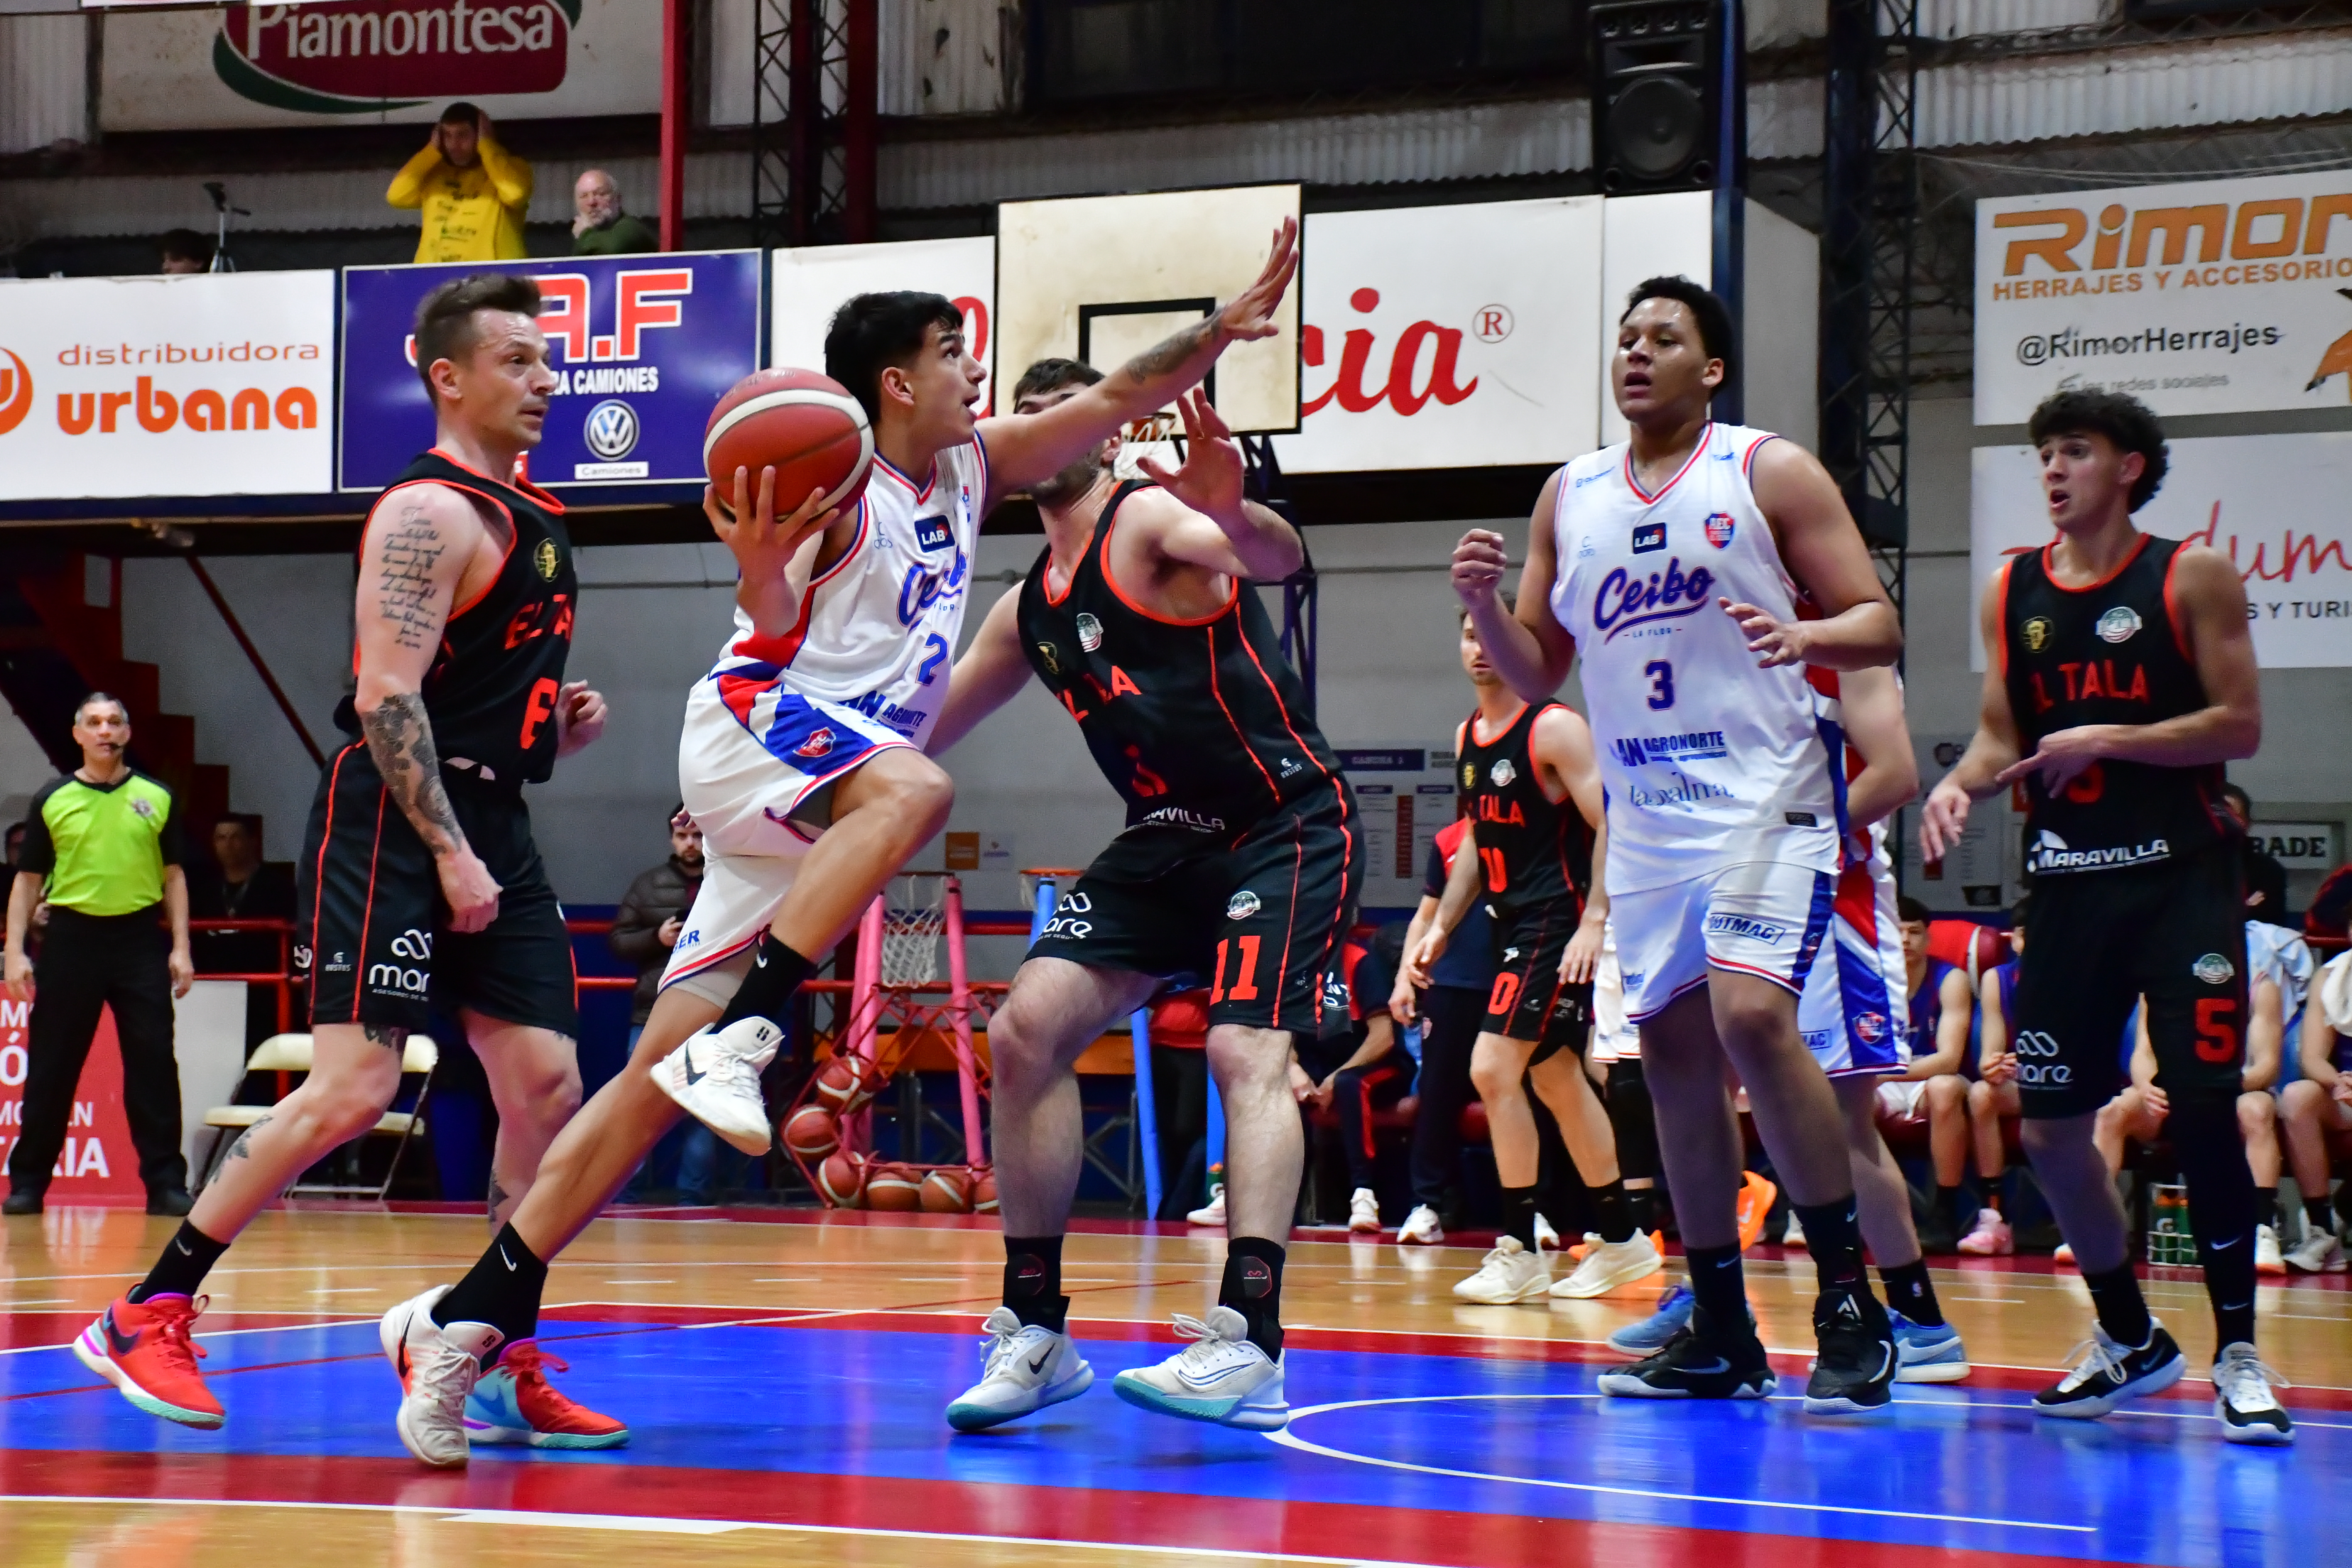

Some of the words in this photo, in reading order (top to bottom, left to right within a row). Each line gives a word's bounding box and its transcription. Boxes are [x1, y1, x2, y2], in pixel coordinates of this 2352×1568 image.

[247, 0, 553, 60] Piamontesa
[1993, 273, 2142, 301] HERRAJES
[2156, 271, 2171, 289] Y
[58, 341, 319, 366] distribuidora
[2017, 323, 2279, 366] @RimorHerrajes
[573, 367, 659, 395] CAMIONES
[57, 376, 317, 435] urbana
[581, 466, 642, 476] Camiones
[921, 529, 946, 545] LAB
[1634, 535, 1660, 548] LAB
[1593, 556, 1716, 631] Ceibo
[2267, 601, 2283, 618] Y
[916, 631, 950, 686] 2
[1644, 659, 1675, 712] 3
[2058, 659, 2151, 707] TALA
[1143, 807, 1225, 830] AVILLA
[2037, 840, 2170, 867] MARAVILLA
[1043, 917, 1092, 938] are
[368, 964, 430, 992] mar
[1210, 936, 1261, 1006] 11
[1488, 972, 1520, 1015] 0
[2195, 998, 2236, 1063] 5
